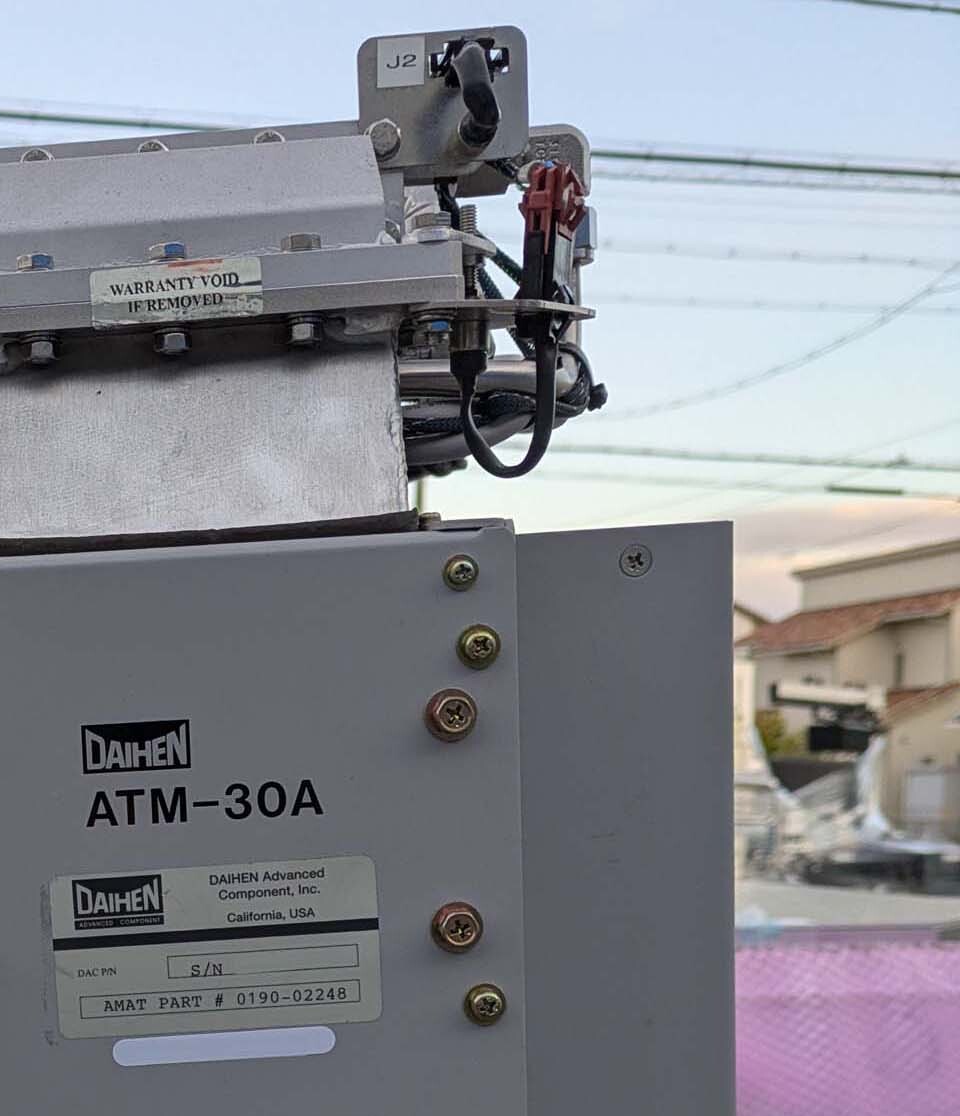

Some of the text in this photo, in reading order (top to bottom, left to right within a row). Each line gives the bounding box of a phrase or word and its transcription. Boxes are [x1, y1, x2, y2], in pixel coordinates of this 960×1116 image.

[385, 53, 417, 69] J2
[110, 272, 239, 297] WARRANTY VOID
[128, 293, 223, 313] IF REMOVED
[84, 723, 188, 771] DAIHEN
[86, 779, 324, 827] ATM-30A
[209, 867, 325, 887] DAIHEN Advanced
[75, 877, 160, 914] DAIHEN
[218, 885, 321, 903] Component, Inc.
[227, 908, 316, 924] California, USA
[77, 967, 117, 978] DAC P/N
[191, 962, 223, 976] S/N
[104, 987, 347, 1013] AMAT PART # 0190-02248
